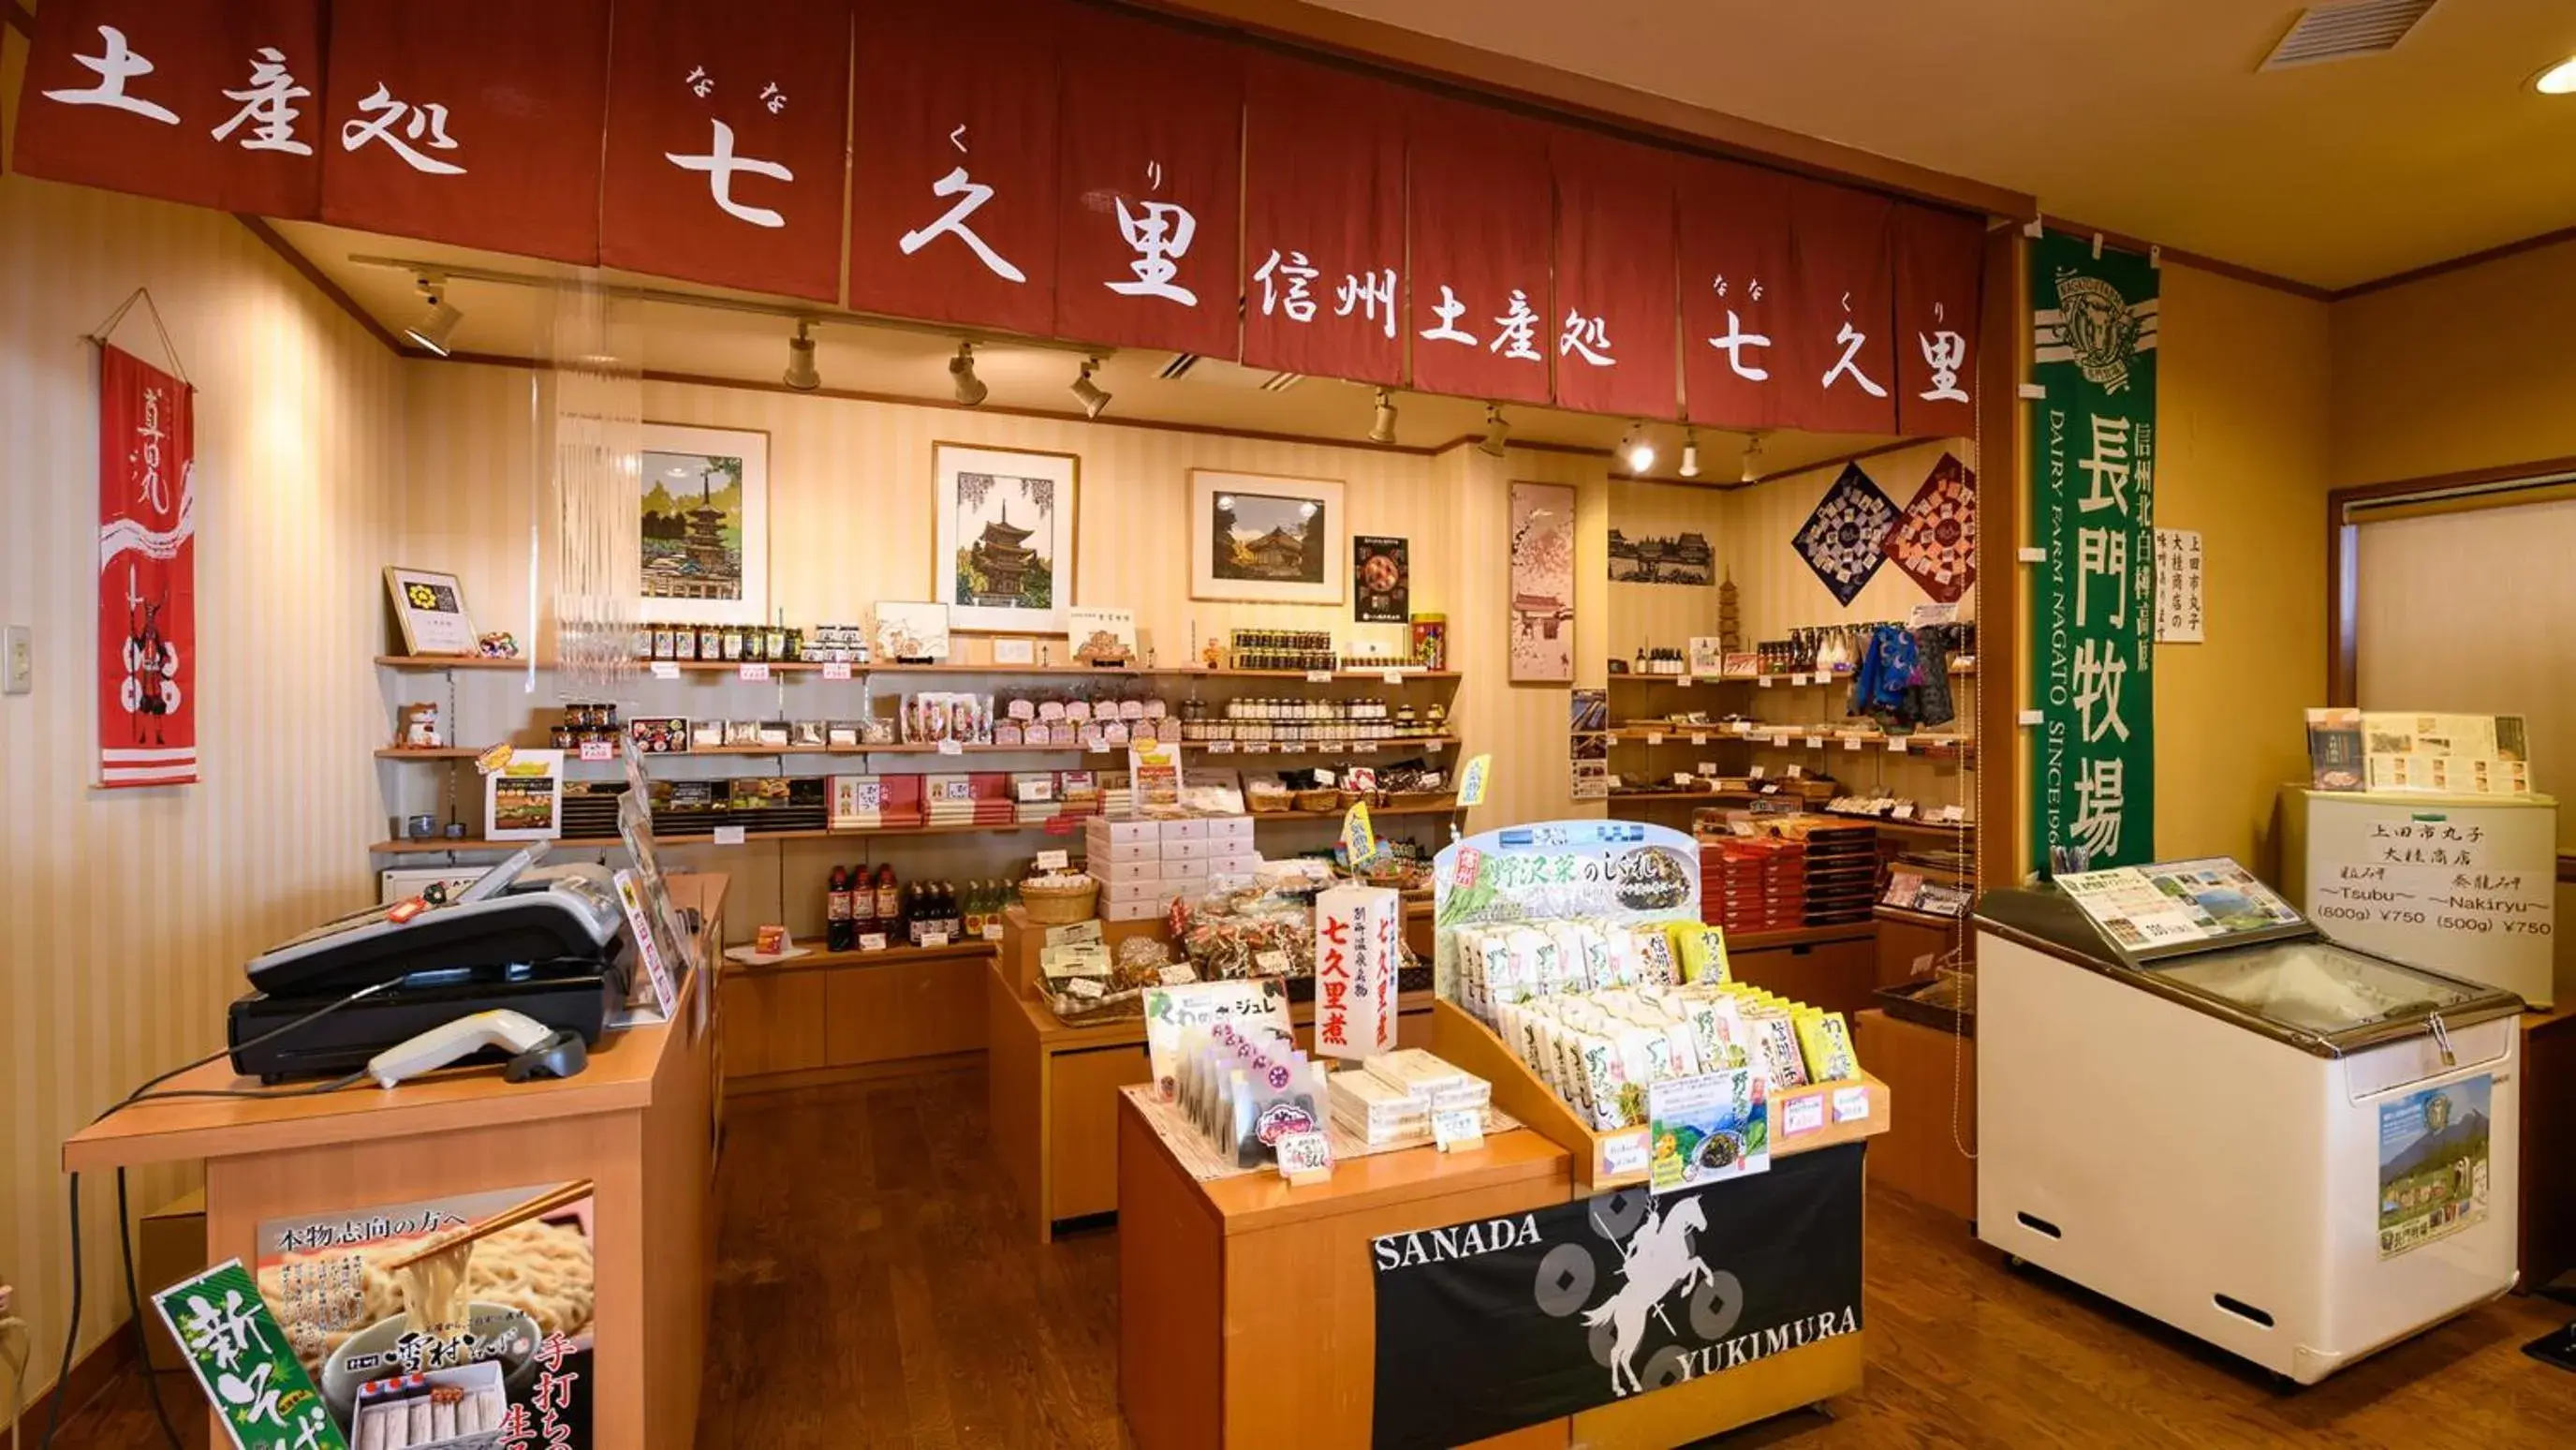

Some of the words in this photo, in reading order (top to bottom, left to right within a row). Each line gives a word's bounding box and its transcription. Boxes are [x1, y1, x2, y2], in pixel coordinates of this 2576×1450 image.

[42, 24, 467, 174] 土産処
[1253, 248, 1397, 339] 信州
[1419, 284, 1617, 367] 土産処
[2050, 408, 2066, 496] DAIRY
[2048, 505, 2064, 583] FARM
[2049, 592, 2068, 706] NAGATO
[2070, 412, 2130, 857] 長門牧場
[1321, 915, 1350, 1046] 七久里煮
[280, 1210, 466, 1251] 本物志向の方へ
[1374, 1213, 1543, 1272] SANADA
[534, 1331, 579, 1450] 手打ち
[1676, 1305, 1858, 1383] YUKIMURA
